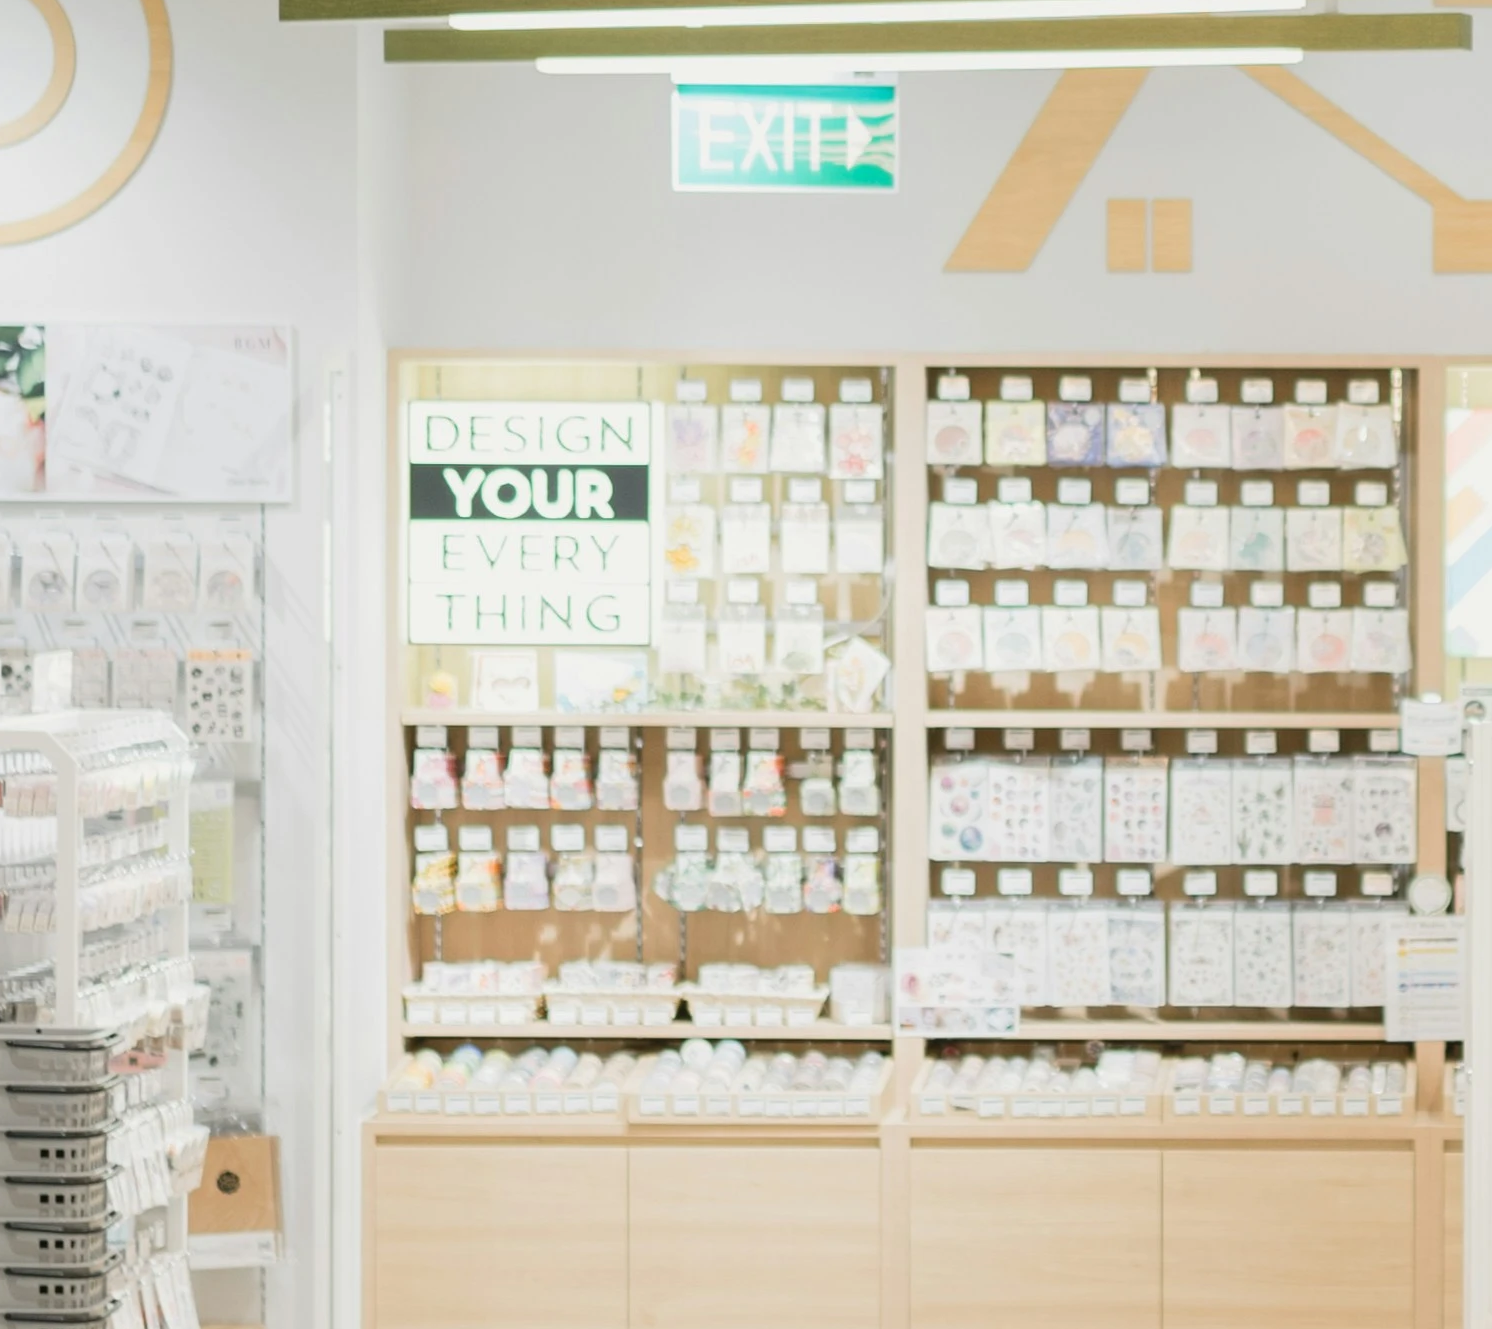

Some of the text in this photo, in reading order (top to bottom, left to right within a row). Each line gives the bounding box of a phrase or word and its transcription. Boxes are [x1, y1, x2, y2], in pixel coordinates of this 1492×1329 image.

[698, 101, 833, 172] EXIT
[425, 415, 635, 454] DESIGN
[443, 468, 614, 520] YOUR
[442, 534, 620, 573] EVERY
[436, 594, 622, 633] THING
